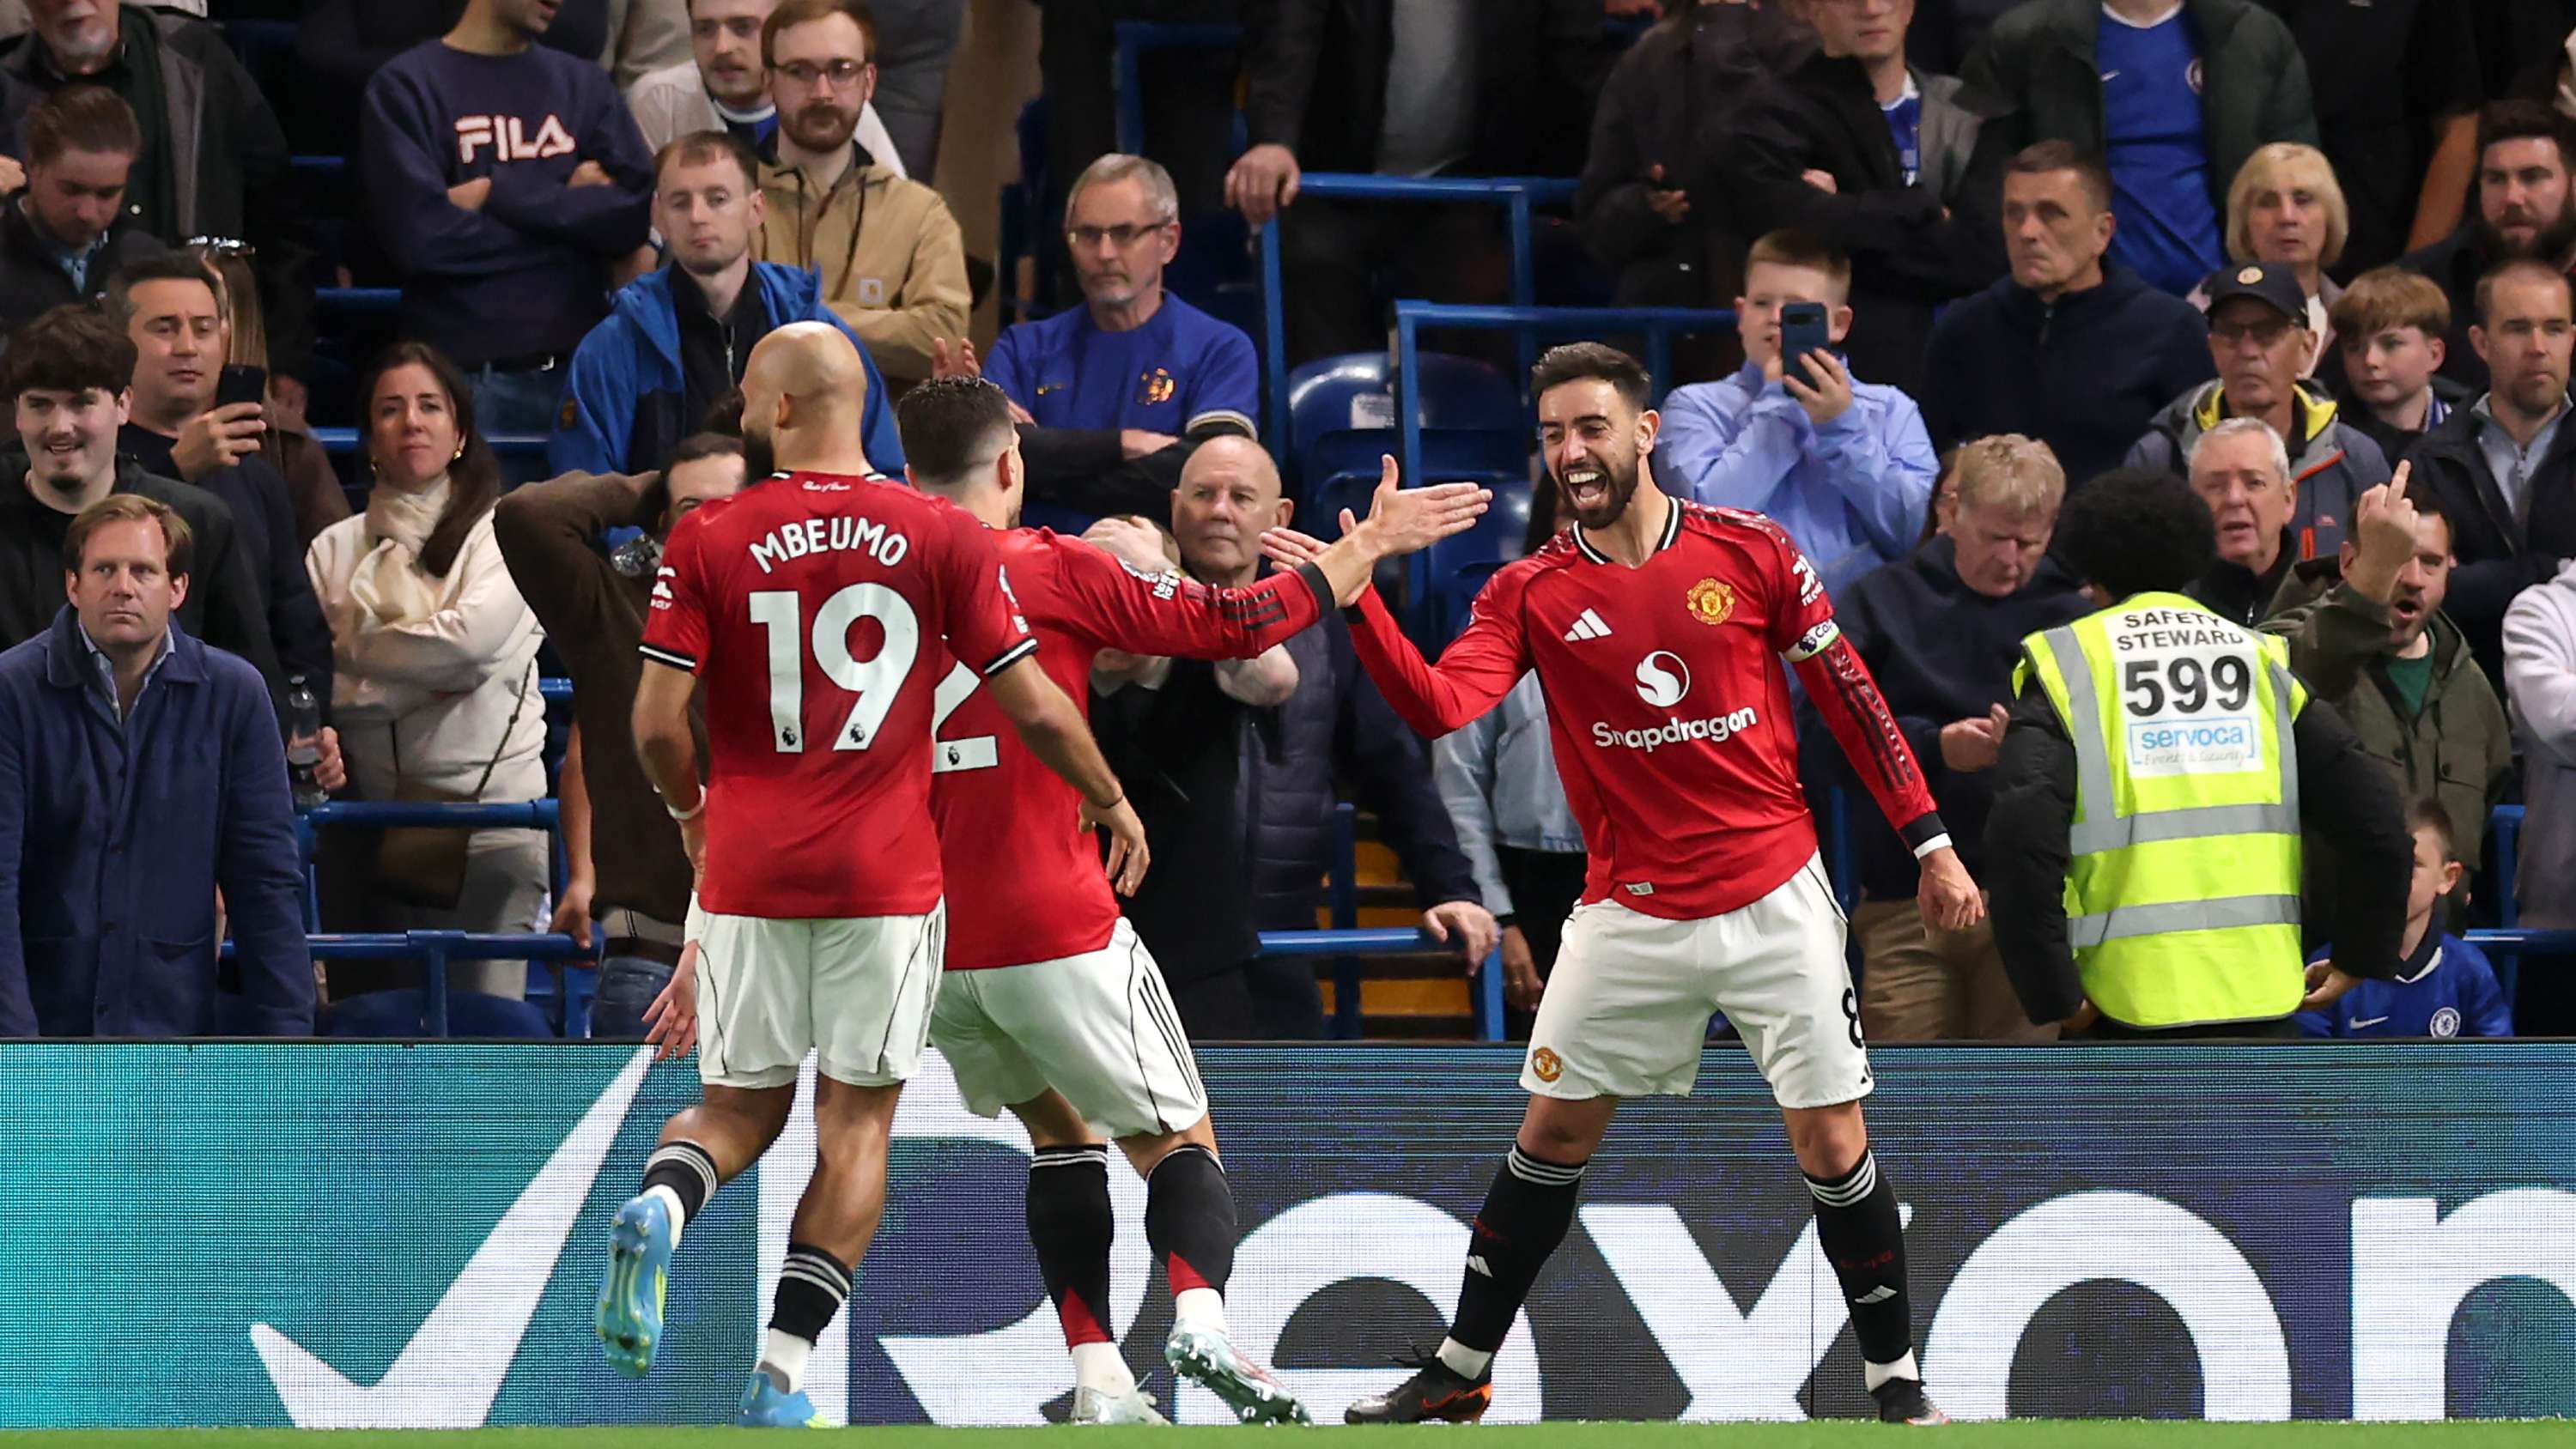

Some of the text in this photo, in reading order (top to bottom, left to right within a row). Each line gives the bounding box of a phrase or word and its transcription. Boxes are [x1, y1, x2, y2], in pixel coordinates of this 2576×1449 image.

[454, 113, 576, 164] FILA
[749, 516, 908, 574] MBEUMO
[2117, 630, 2244, 651] STEWARD
[2124, 610, 2221, 628] SAFETY
[749, 582, 920, 753] 19
[2125, 655, 2251, 717] 599
[1592, 706, 1757, 753] Snapdragon
[2142, 726, 2243, 749] servoca
